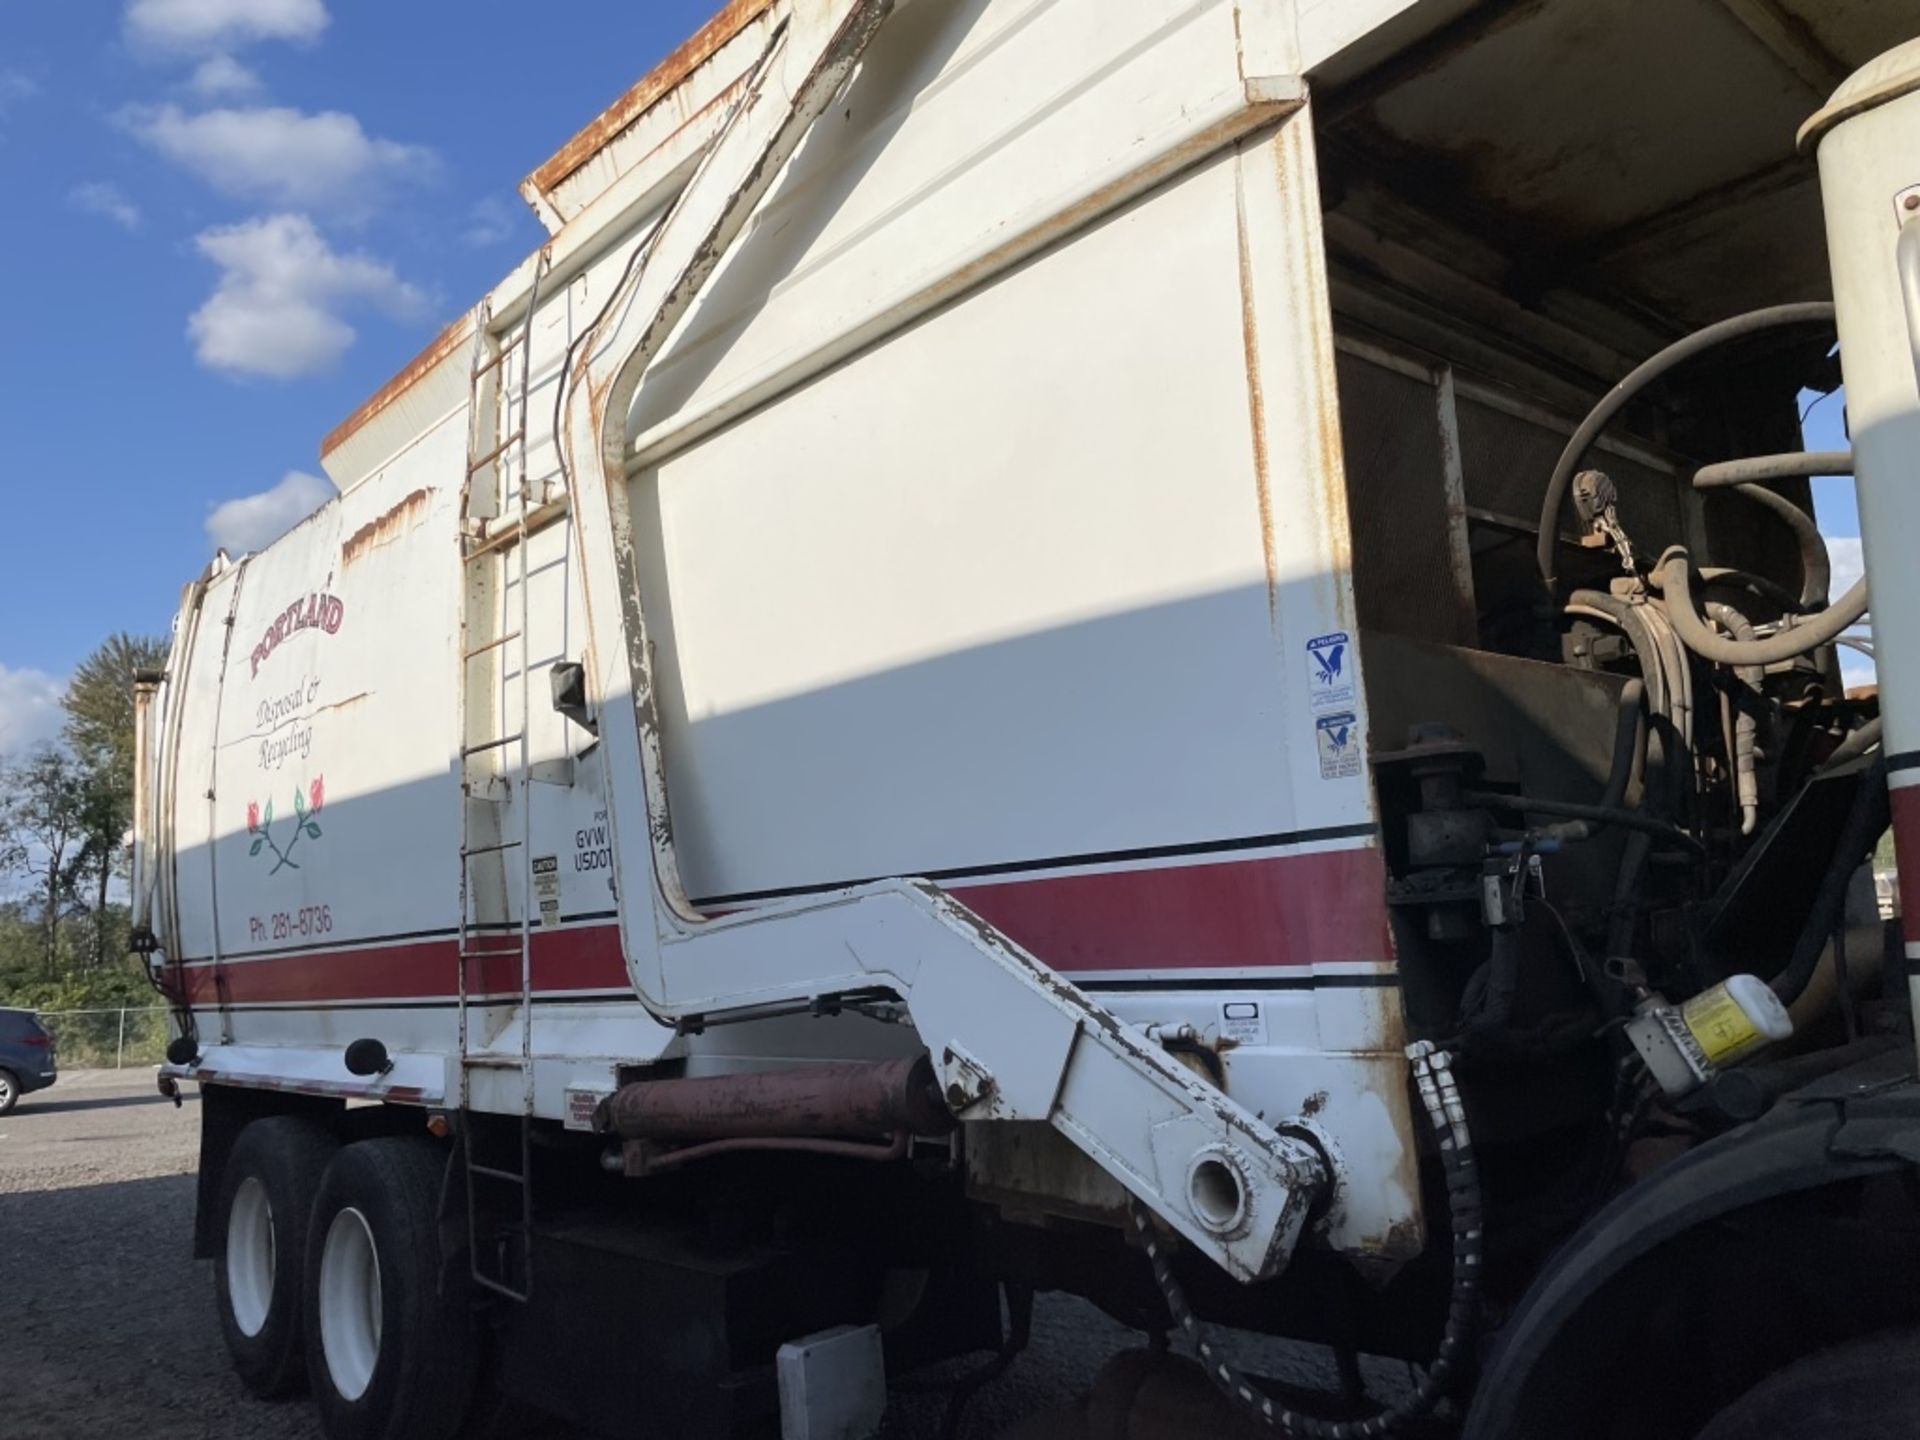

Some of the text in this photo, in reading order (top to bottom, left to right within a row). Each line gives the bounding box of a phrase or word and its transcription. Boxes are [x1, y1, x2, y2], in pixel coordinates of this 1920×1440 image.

[250, 593, 344, 680] PORTLAND
[256, 675, 305, 731] Disposal
[258, 722, 313, 770] Recycling
[575, 827, 606, 848] GVW
[271, 905, 332, 940] 281-8736
